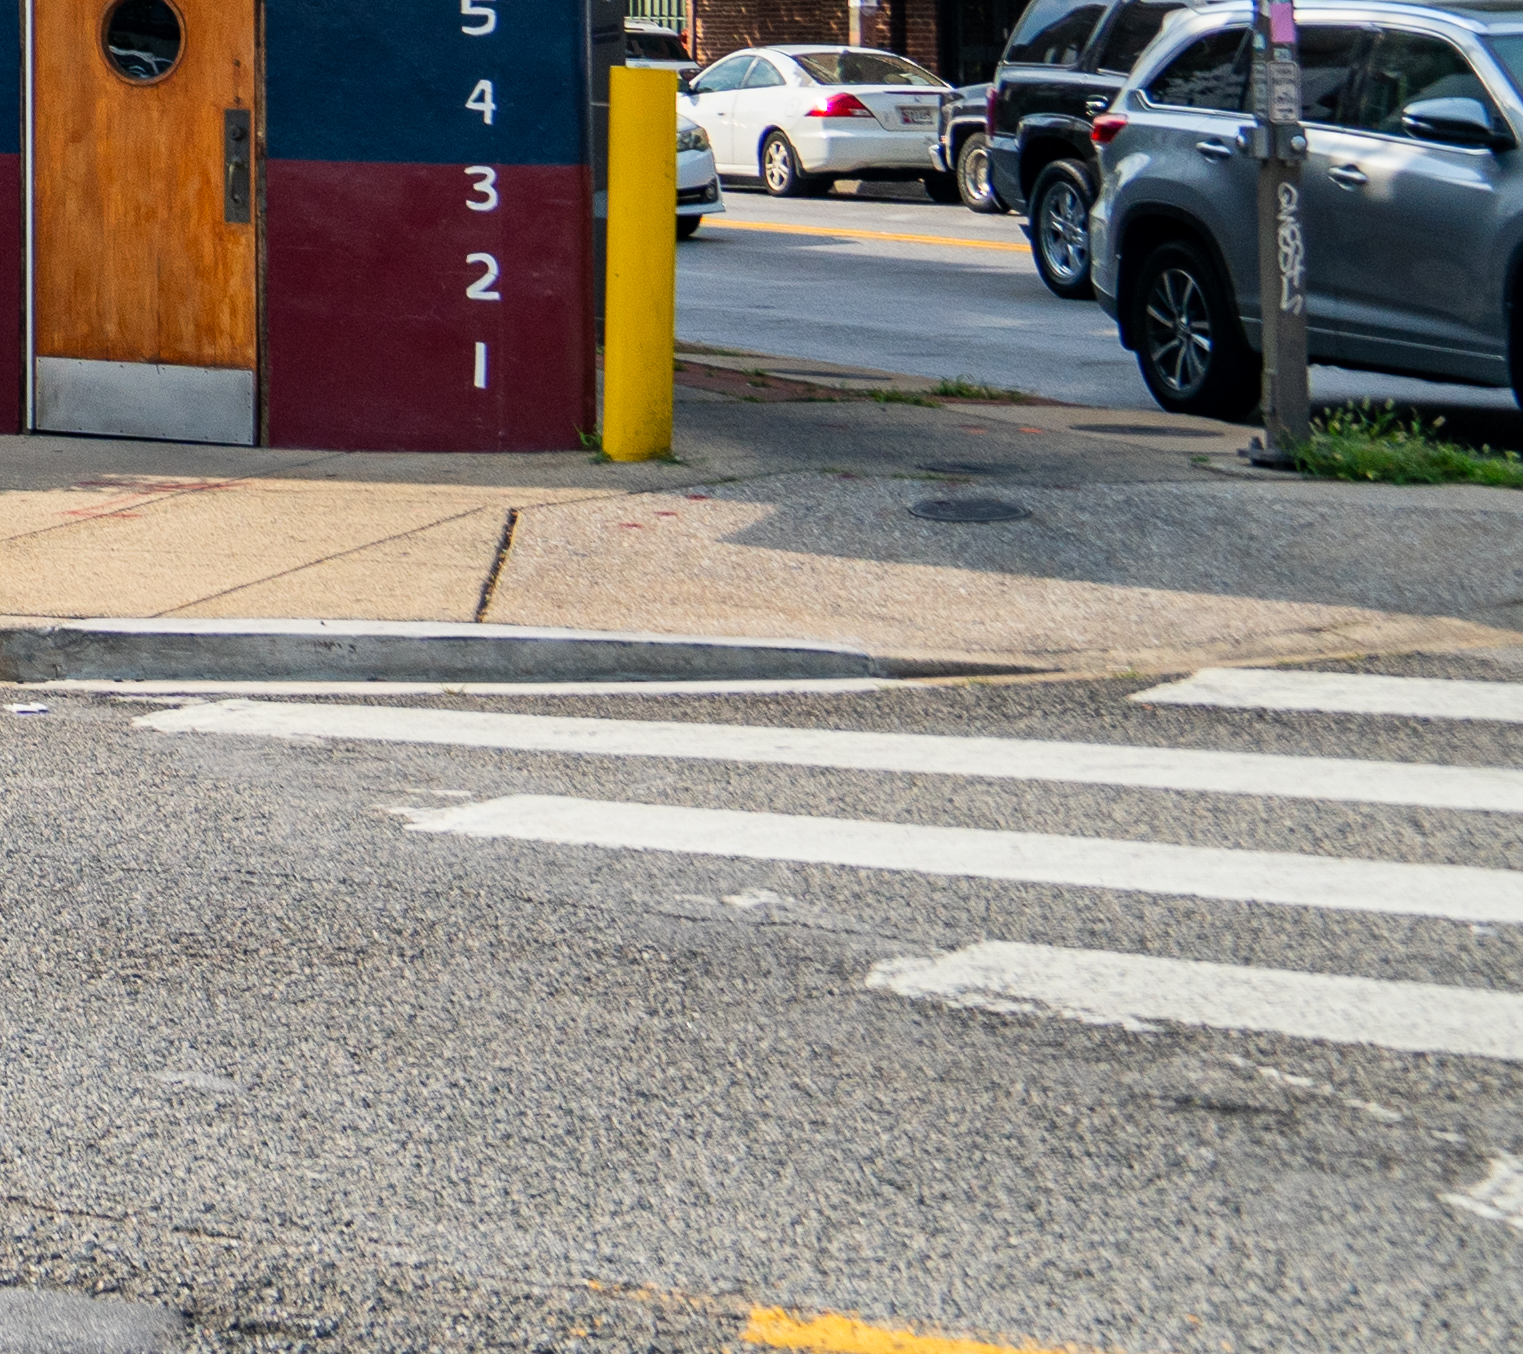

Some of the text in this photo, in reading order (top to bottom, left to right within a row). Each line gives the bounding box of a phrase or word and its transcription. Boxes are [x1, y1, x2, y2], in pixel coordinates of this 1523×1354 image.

[465, 80, 496, 125] 4
[466, 165, 498, 212] 3
[466, 252, 500, 301] 2
[473, 342, 487, 389] 1
